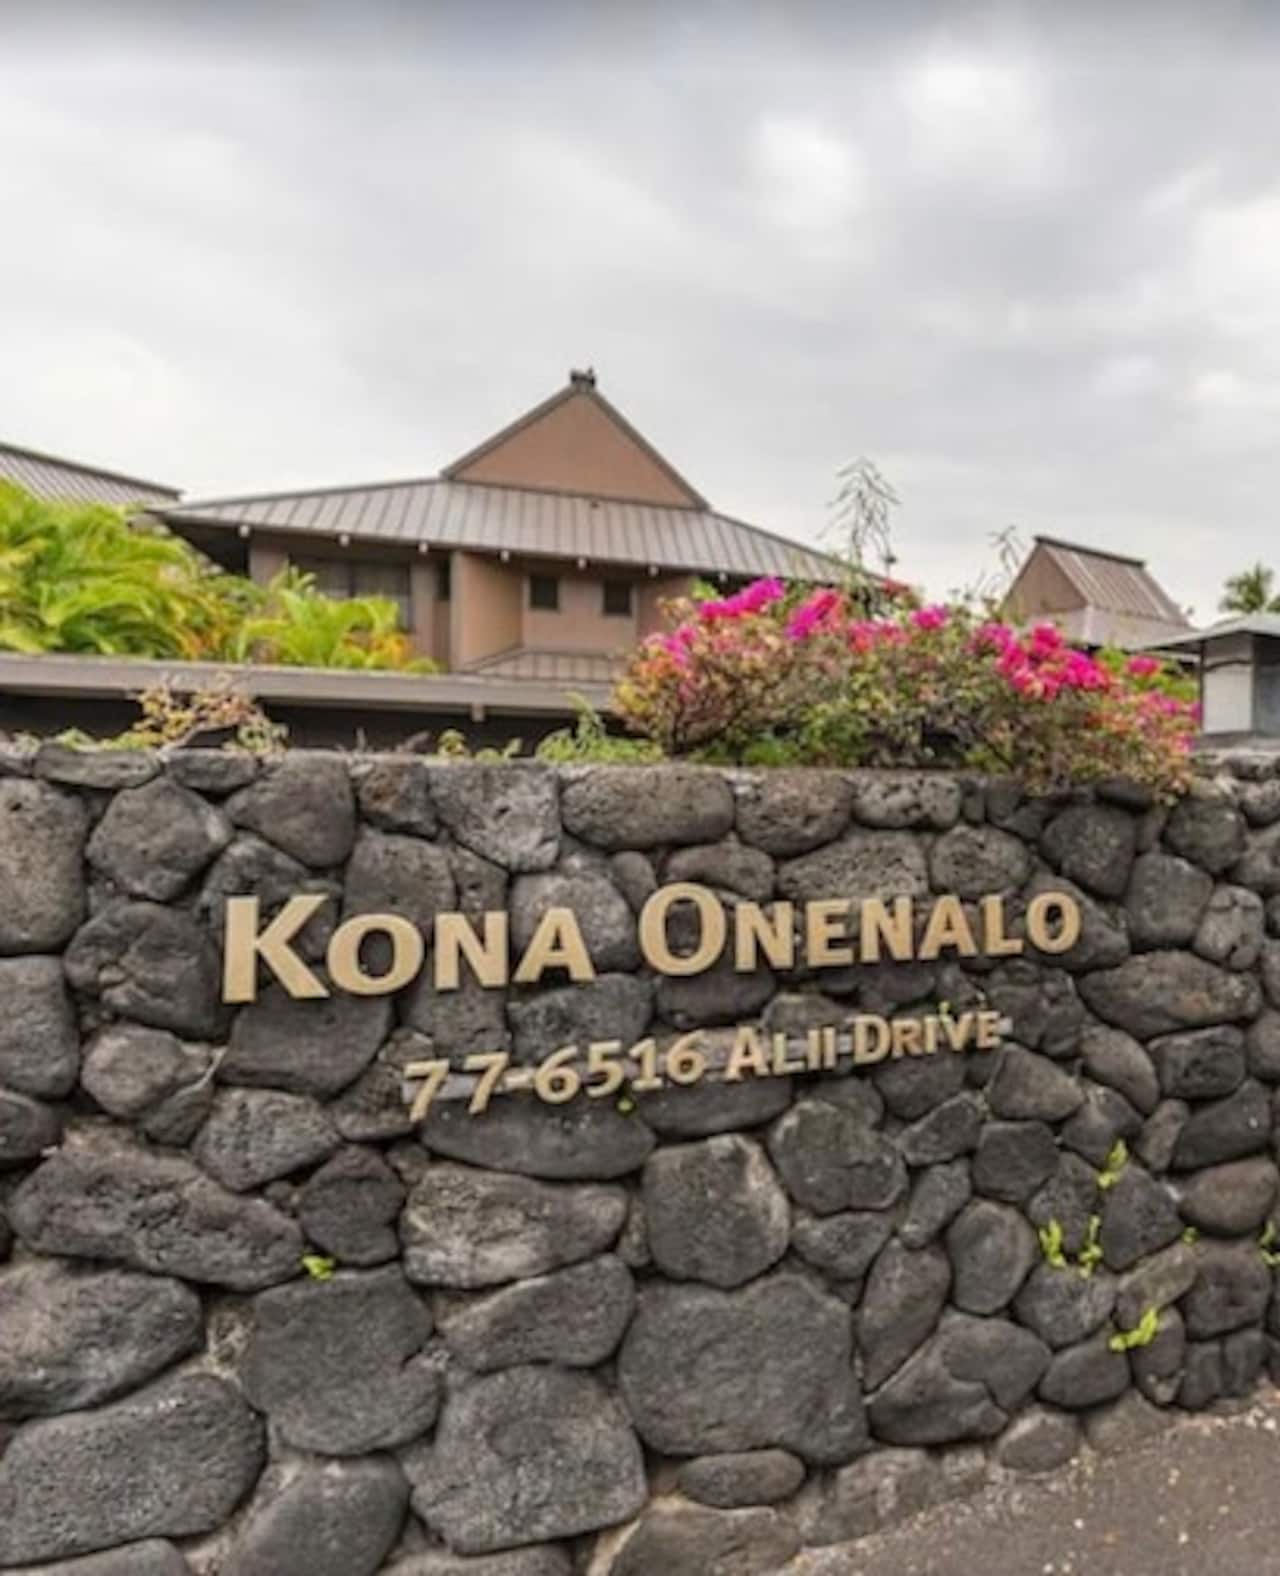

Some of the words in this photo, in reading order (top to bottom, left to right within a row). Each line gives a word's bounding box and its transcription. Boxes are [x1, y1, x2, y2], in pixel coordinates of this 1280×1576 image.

[224, 895, 596, 1003] KONA
[639, 882, 1082, 976] ONENALO
[404, 1030, 704, 1121] 77-6516
[725, 1026, 836, 1079] ALII
[853, 1010, 1001, 1065] DRIVE
